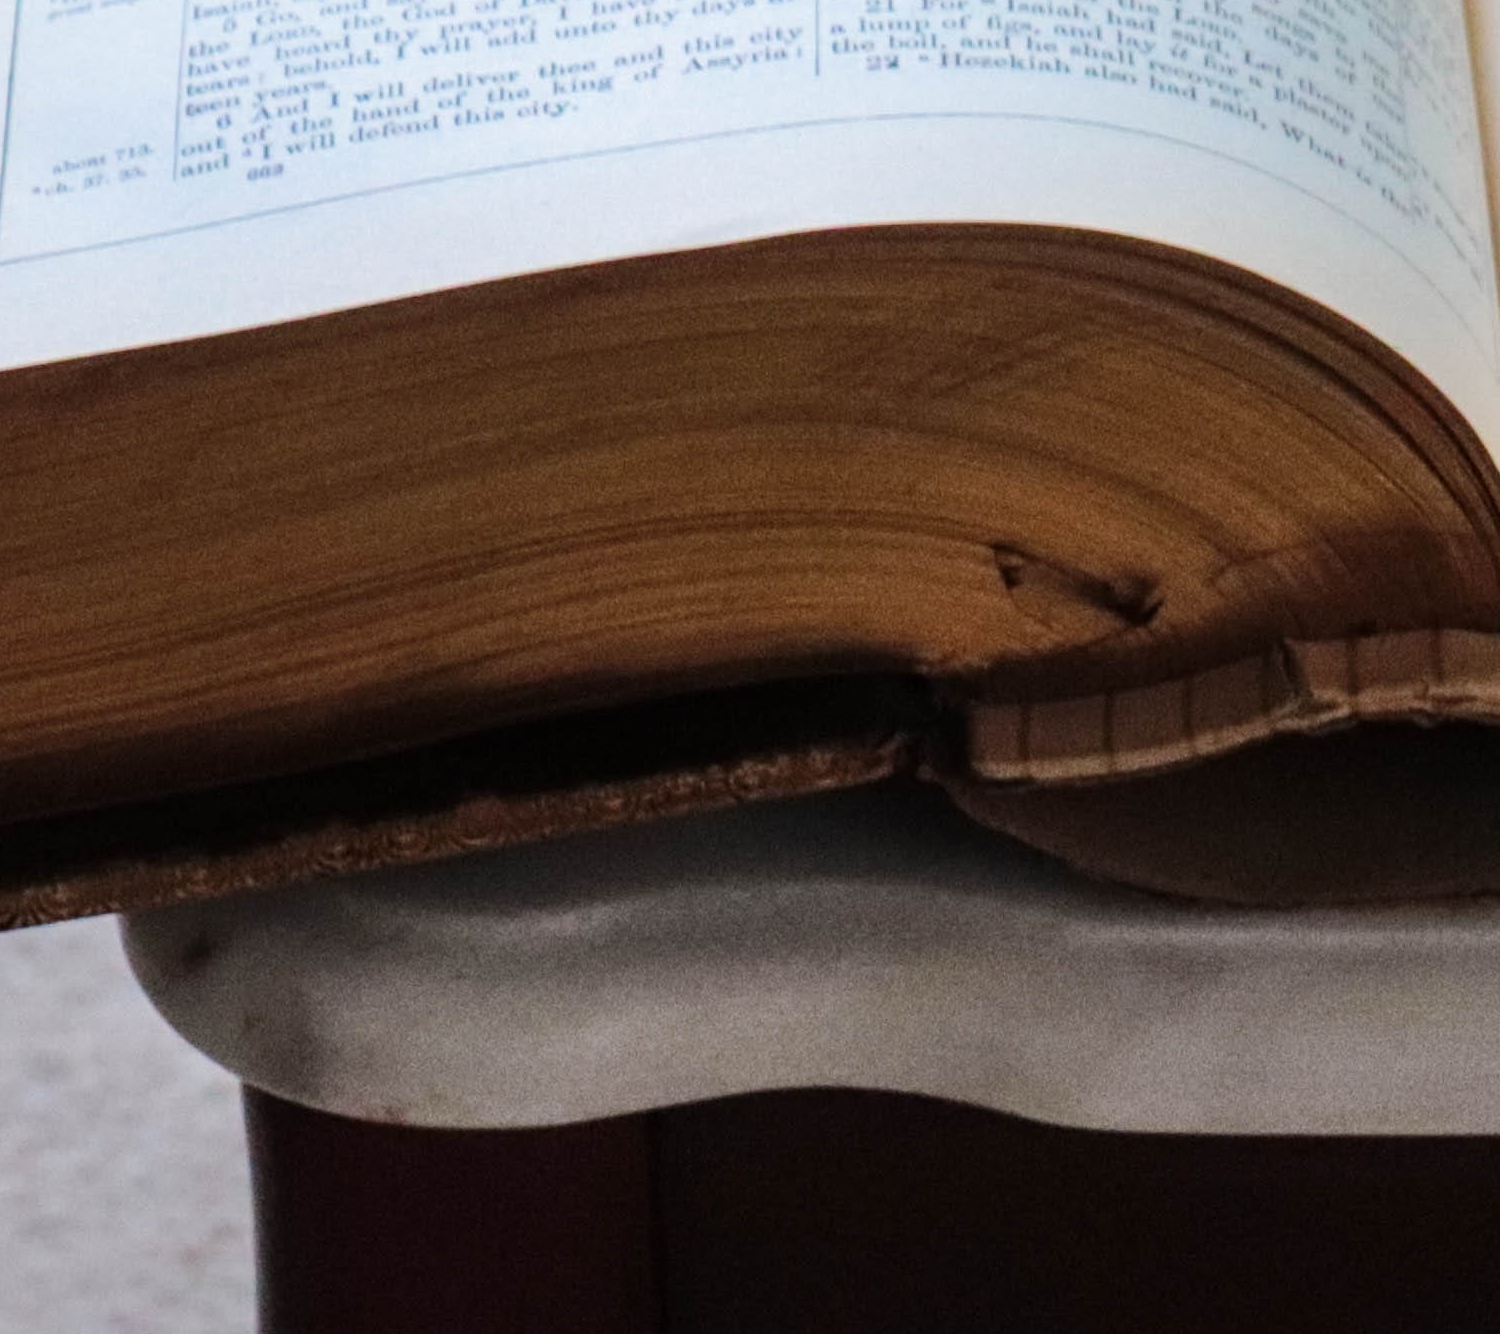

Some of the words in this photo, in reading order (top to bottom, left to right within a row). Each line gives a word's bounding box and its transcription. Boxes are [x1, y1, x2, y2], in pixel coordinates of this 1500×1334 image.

[188, 40, 230, 59] the
[342, 14, 384, 31] the
[402, 2, 455, 21] God
[188, 55, 250, 78] have
[275, 35, 350, 62] heard
[373, 25, 418, 46] thy
[284, 49, 380, 78] behold,
[420, 36, 471, 56] will
[488, 28, 536, 47] add
[554, 20, 617, 40] unto
[633, 9, 679, 28] thy
[859, 18, 930, 34] lump
[942, 15, 971, 29] of
[987, 15, 1040, 35] figs,
[1054, 24, 1101, 41] and
[1117, 30, 1155, 53] lay
[1171, 47, 1187, 60] it
[1204, 54, 1237, 76] for
[1108, 9, 1155, 33] had
[1171, 30, 1230, 58] said,
[1245, 51, 1282, 79] Let
[1299, 77, 1353, 120] them
[186, 95, 241, 117] teen
[255, 80, 332, 107] years.
[252, 99, 309, 122] And
[354, 81, 404, 103] will
[422, 70, 520, 93] deliver
[539, 60, 596, 78] thee
[614, 45, 665, 68] and
[684, 34, 735, 55] this
[749, 26, 803, 45] city
[832, 38, 874, 54] the
[889, 35, 946, 49] boil,
[960, 35, 1010, 49] and
[1027, 38, 1057, 51] he
[1070, 44, 1135, 66] shall
[1149, 61, 1249, 100] recover.
[181, 136, 225, 157] out
[242, 124, 271, 145] of
[290, 116, 332, 135] the
[352, 99, 418, 123] hand
[437, 90, 467, 110] of
[488, 87, 529, 103] the
[553, 76, 613, 95] king
[633, 63, 664, 83] of
[181, 153, 230, 177] and
[285, 131, 335, 155] will
[349, 115, 438, 143] defend
[454, 105, 505, 127] this
[517, 100, 578, 117] city.
[1083, 64, 1137, 85] also
[1150, 77, 1196, 100] had
[1209, 97, 1267, 129] said,
[1281, 121, 1345, 167] What
